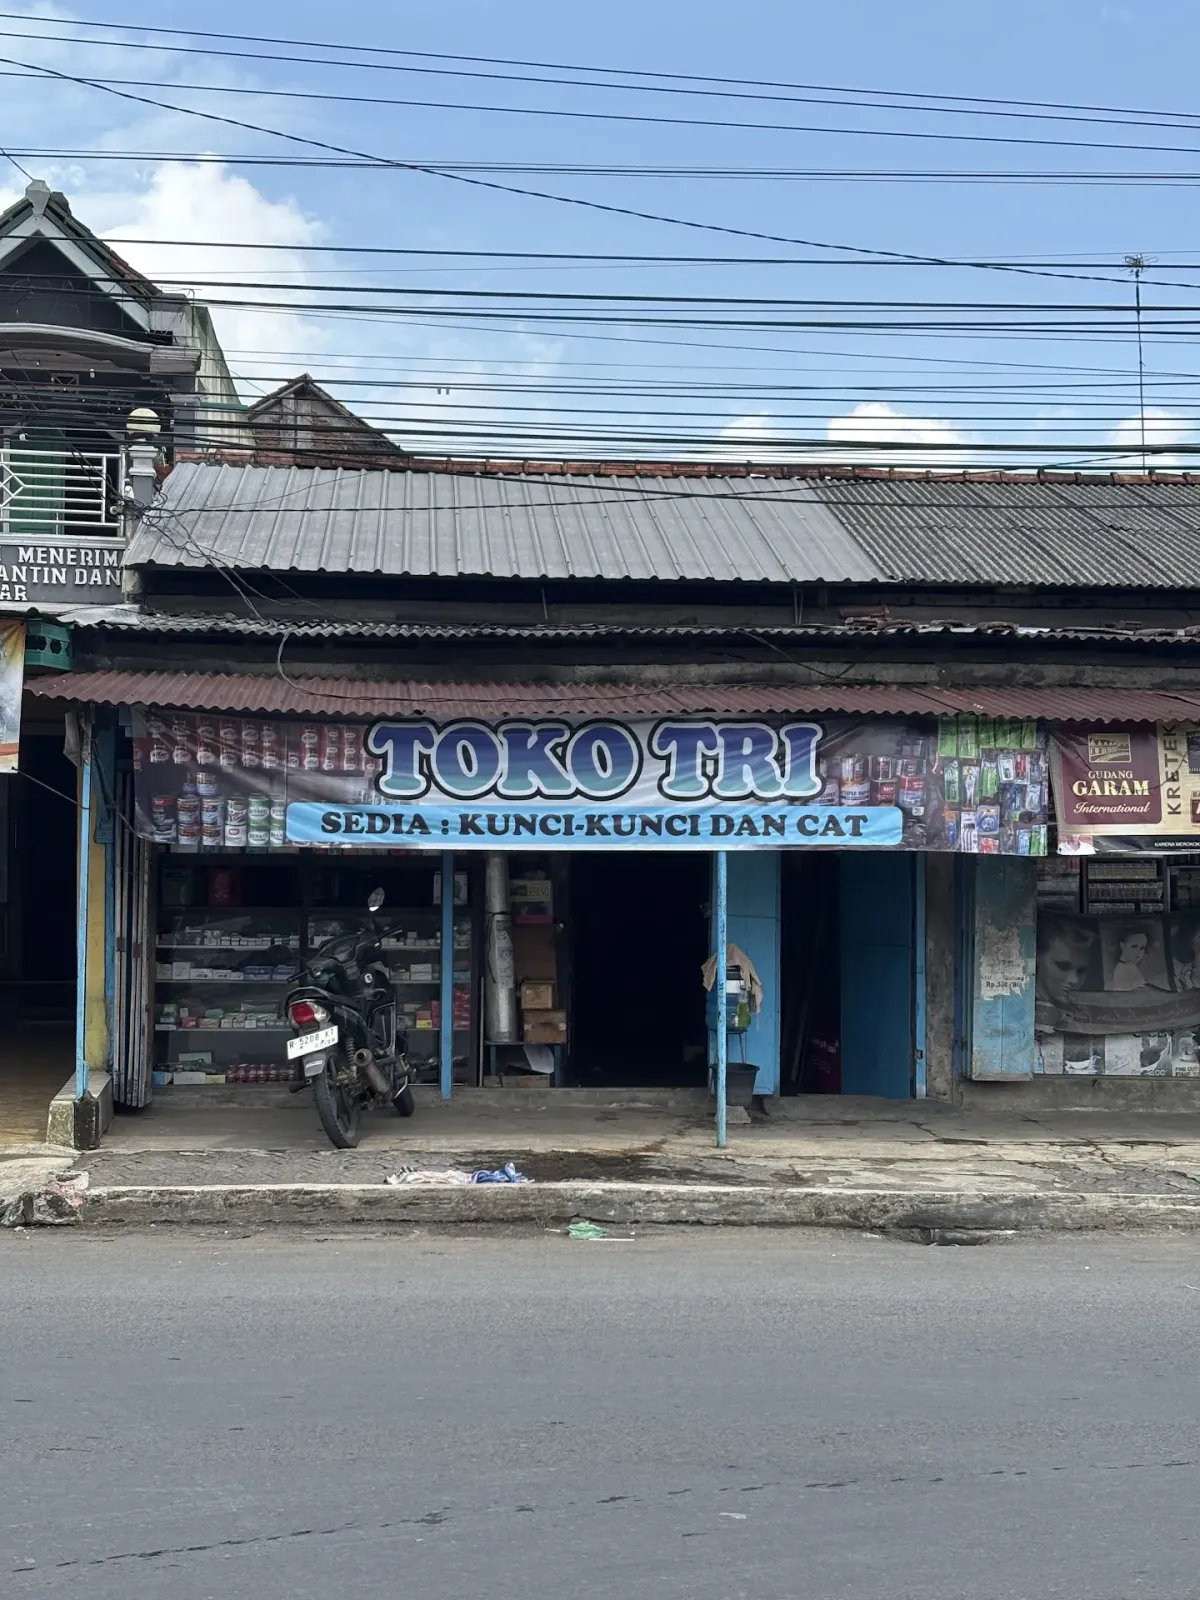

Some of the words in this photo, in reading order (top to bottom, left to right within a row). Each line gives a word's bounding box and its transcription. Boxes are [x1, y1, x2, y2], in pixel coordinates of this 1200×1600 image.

[74, 568, 121, 586] DAN
[364, 717, 643, 801] TOKO
[648, 717, 827, 801] TRI
[1088, 770, 1134, 779] GUDANG
[1162, 722, 1181, 815] KRETEK
[1072, 779, 1151, 797] GARAM
[1073, 801, 1151, 814] International
[321, 811, 432, 835] SEDIA
[458, 812, 701, 836] KUNCI-KUNCI
[709, 814, 787, 837] DAN
[796, 814, 868, 836] CAT
[289, 1040, 295, 1050] R
